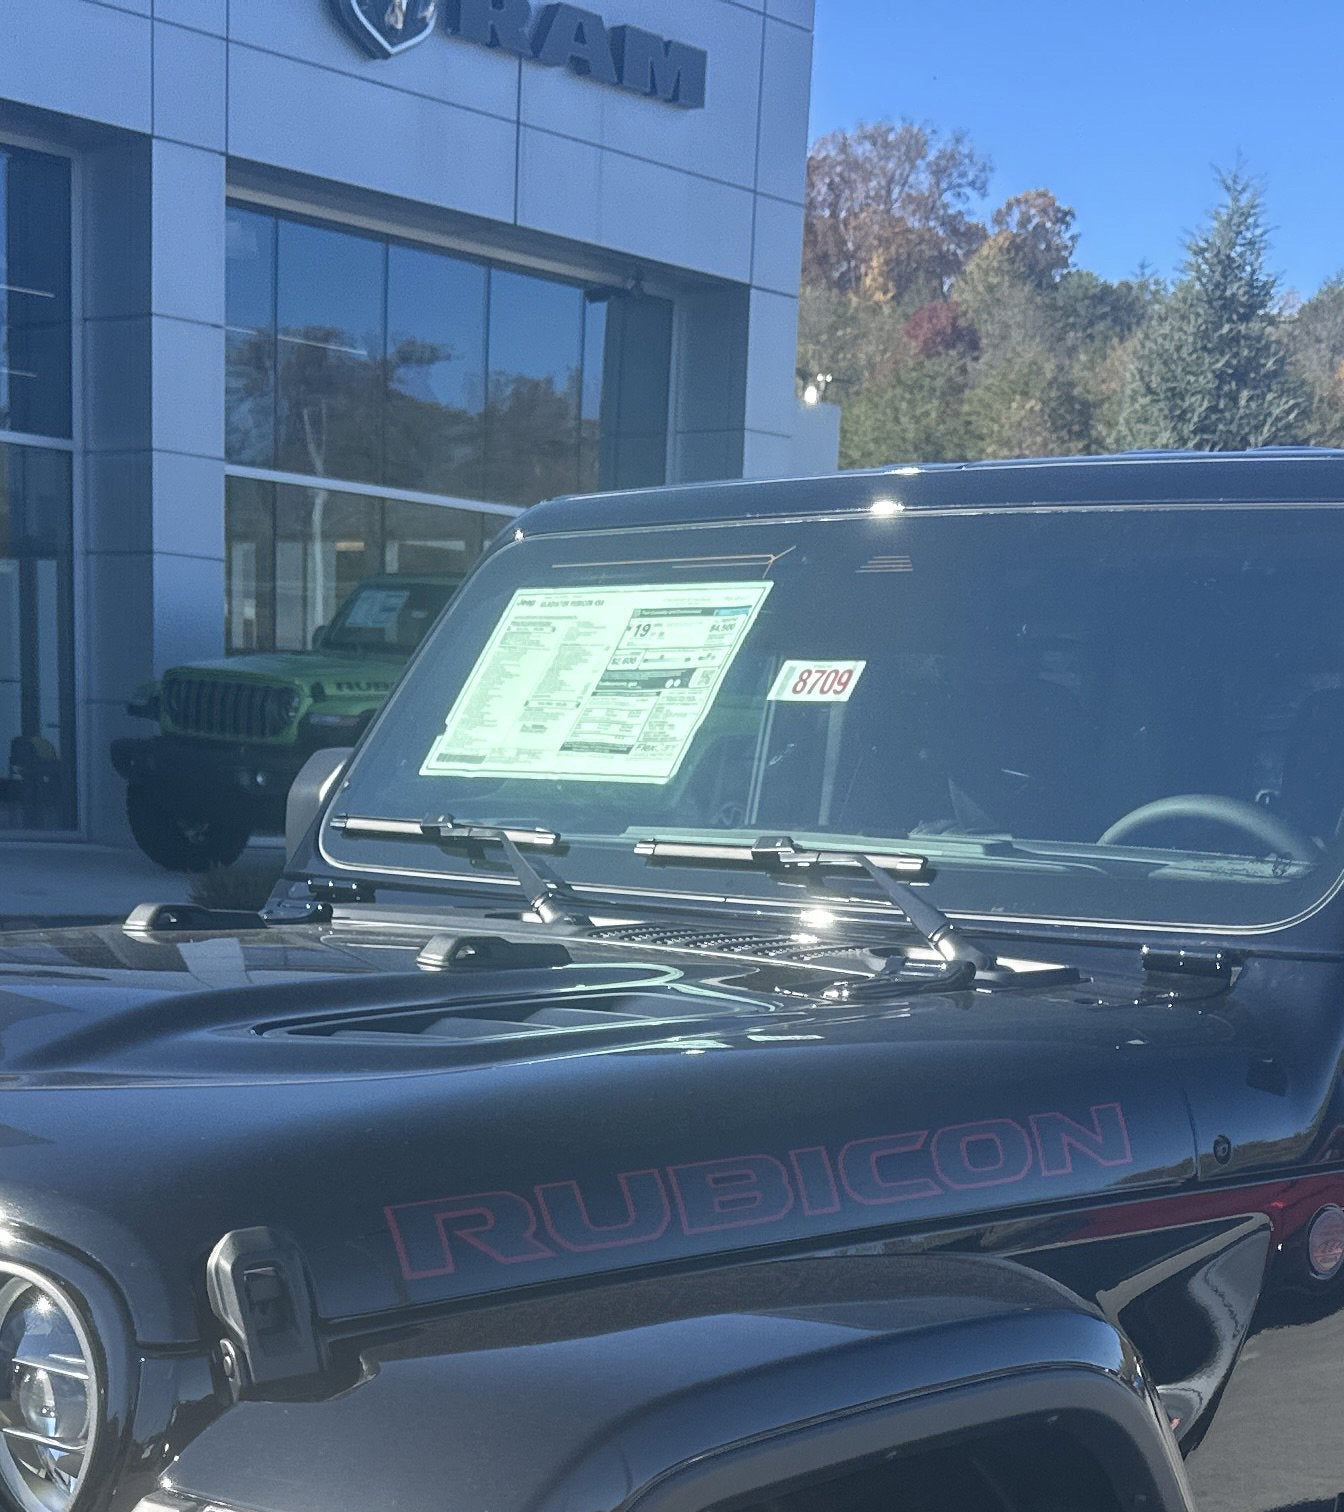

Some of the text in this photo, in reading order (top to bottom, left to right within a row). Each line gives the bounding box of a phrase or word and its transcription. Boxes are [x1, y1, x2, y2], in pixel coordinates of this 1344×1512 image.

[445, 0, 707, 109] RAM
[633, 623, 652, 637] 19
[791, 668, 854, 695] 8709
[384, 1102, 1134, 1280] RUBICON
